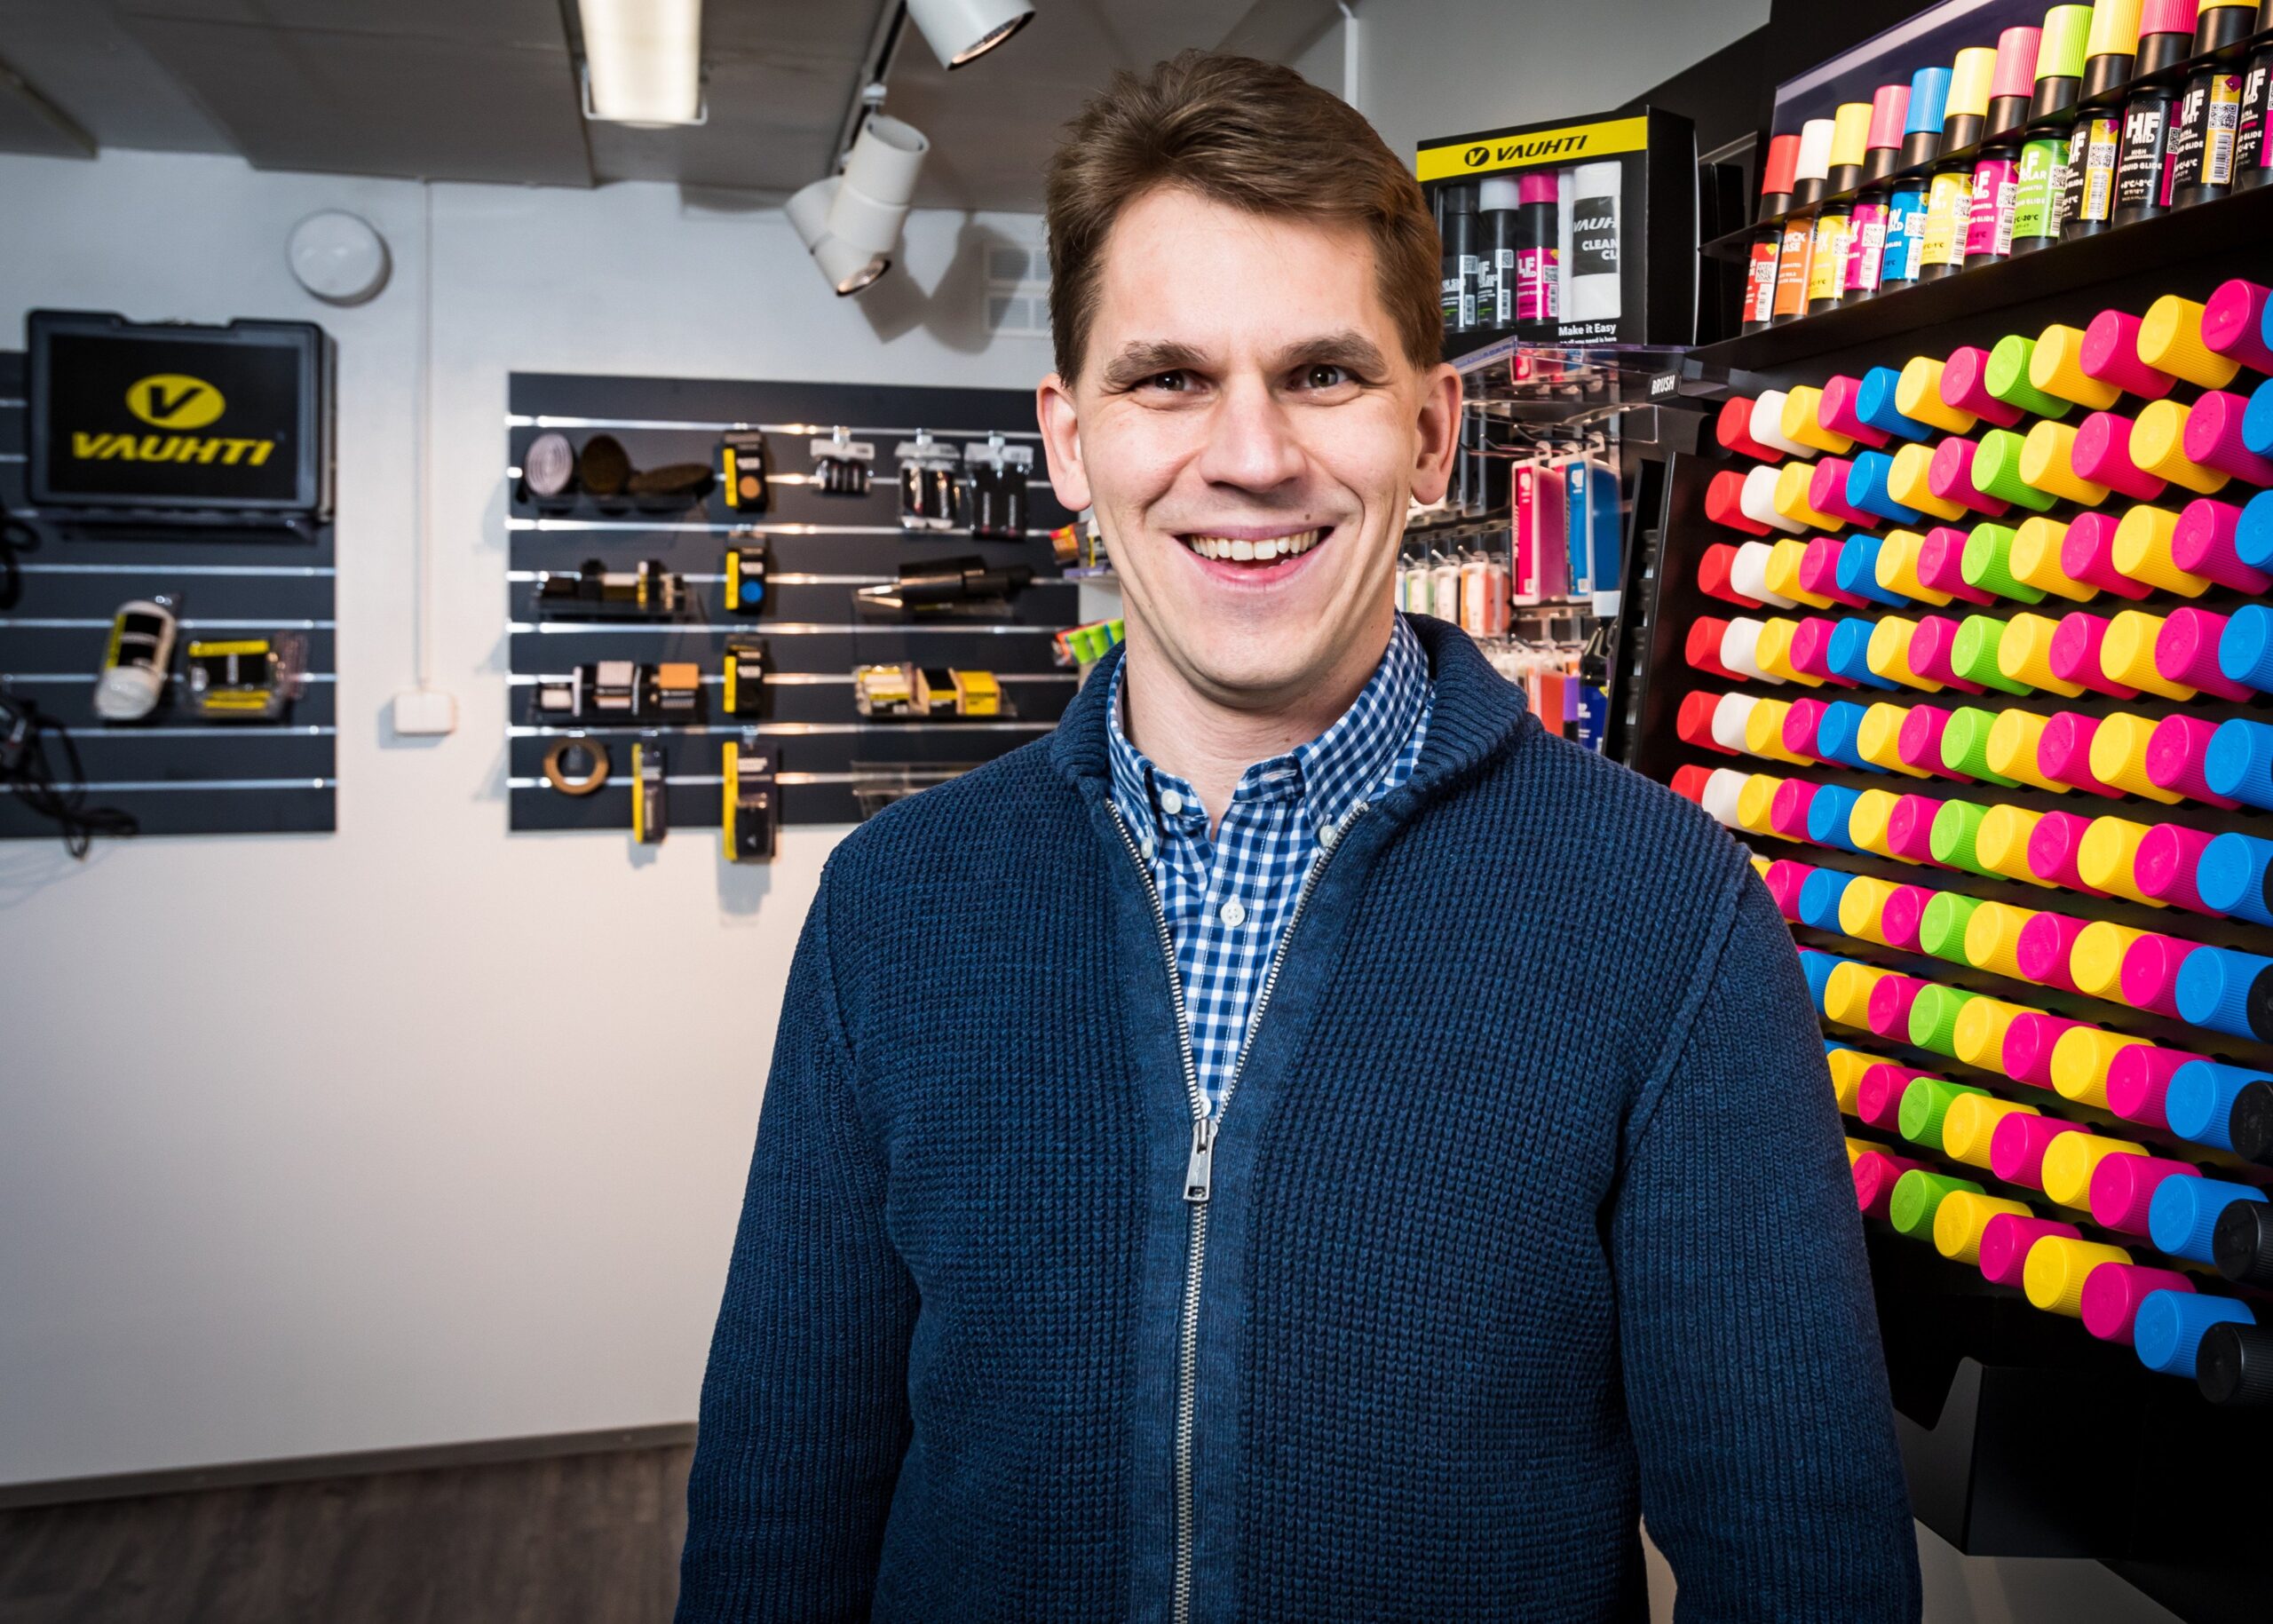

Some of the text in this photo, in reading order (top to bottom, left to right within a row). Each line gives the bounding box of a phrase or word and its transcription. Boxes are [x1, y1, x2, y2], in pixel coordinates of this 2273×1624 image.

[2126, 112, 2161, 139] HF
[2132, 133, 2156, 146] MID
[2244, 130, 2262, 139] GLIDE
[1496, 135, 1588, 162] VAUHTI
[2185, 140, 2205, 150] GLIDE
[1558, 323, 1617, 337] Make it Easy
[1651, 375, 1675, 395] BRUSH
[72, 432, 274, 466] VAUHTI
